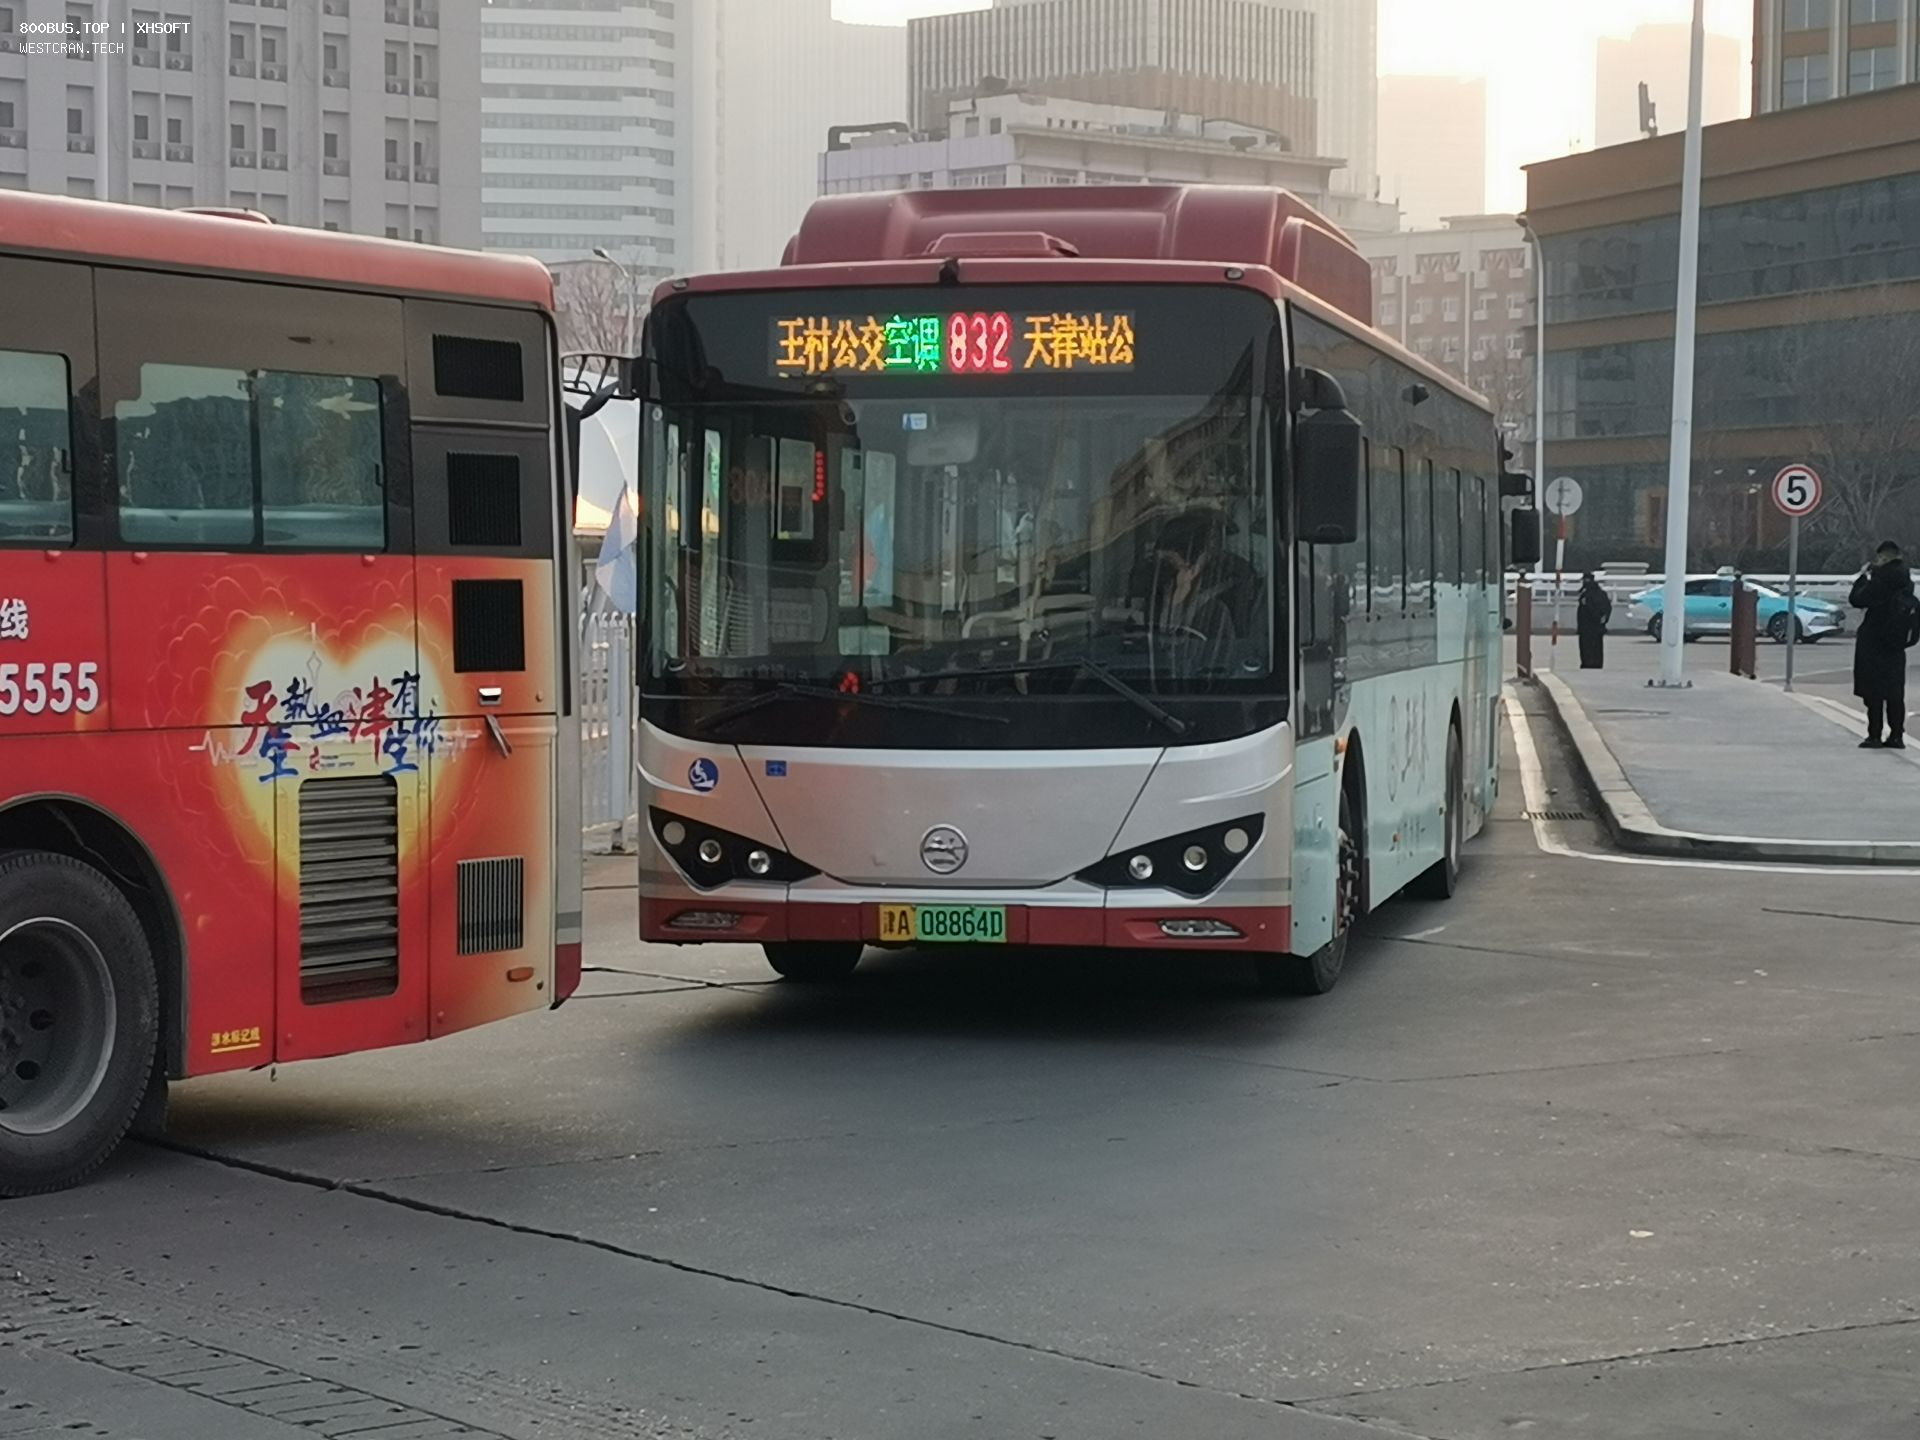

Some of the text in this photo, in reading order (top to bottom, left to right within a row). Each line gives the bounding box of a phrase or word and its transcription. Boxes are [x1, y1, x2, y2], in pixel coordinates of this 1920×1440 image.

[949, 313, 1011, 371] 832
[1787, 475, 1807, 506] 5
[0, 662, 99, 715] 5555
